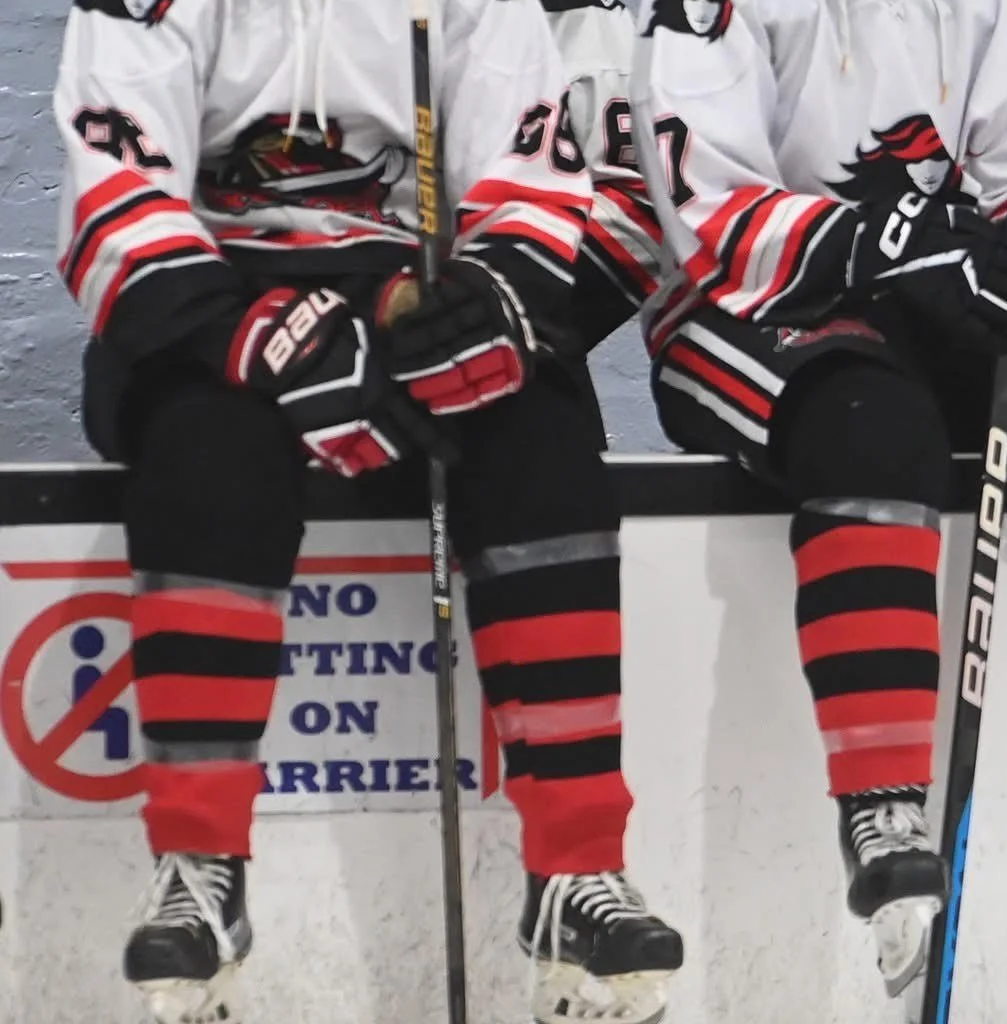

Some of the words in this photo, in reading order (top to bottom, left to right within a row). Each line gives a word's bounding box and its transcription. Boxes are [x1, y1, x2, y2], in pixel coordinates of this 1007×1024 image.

[416, 105, 440, 235] BAUER
[878, 191, 929, 261] CC
[262, 287, 348, 376] BAU
[289, 583, 376, 617] NO
[290, 701, 378, 735] ON
[257, 759, 477, 793] RRIER
